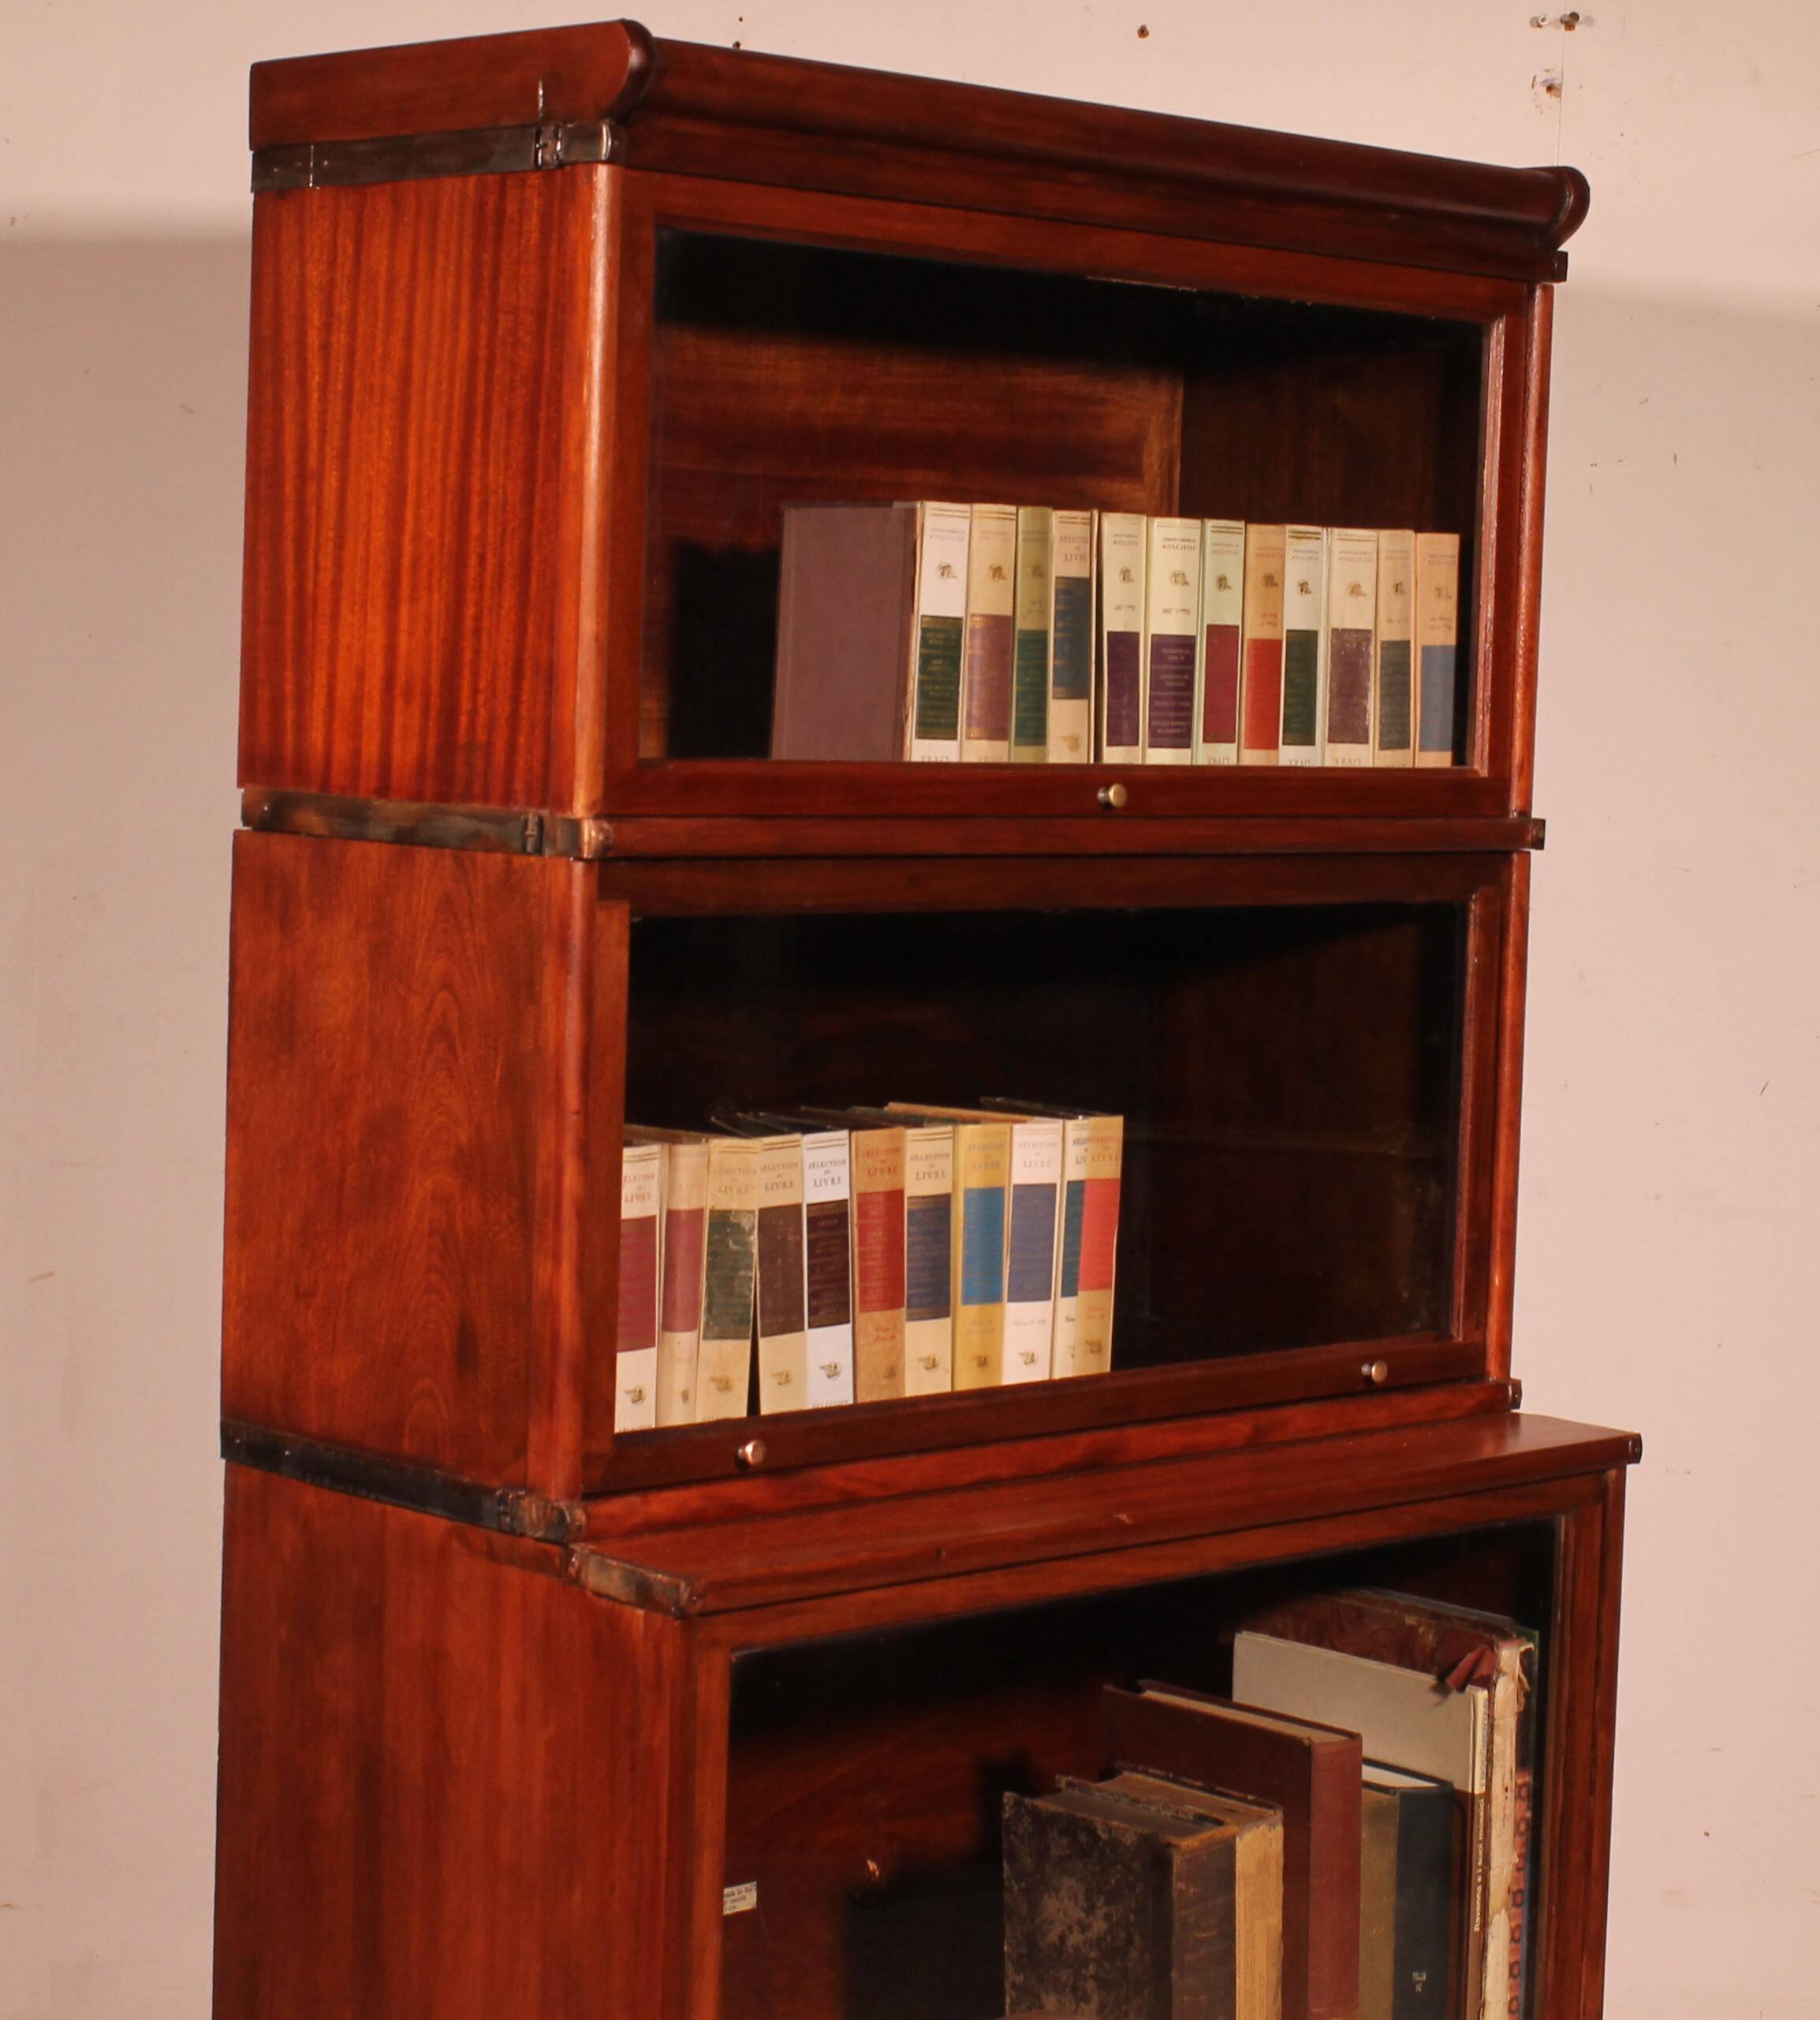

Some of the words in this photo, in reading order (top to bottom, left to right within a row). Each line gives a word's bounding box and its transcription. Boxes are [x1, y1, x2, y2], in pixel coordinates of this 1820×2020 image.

[915, 1169, 946, 1181] LIVRE
[764, 1180, 793, 1192] LIVRE
[813, 1176, 841, 1188] LIVRE
[1474, 1884, 1482, 1932] Ravenna
